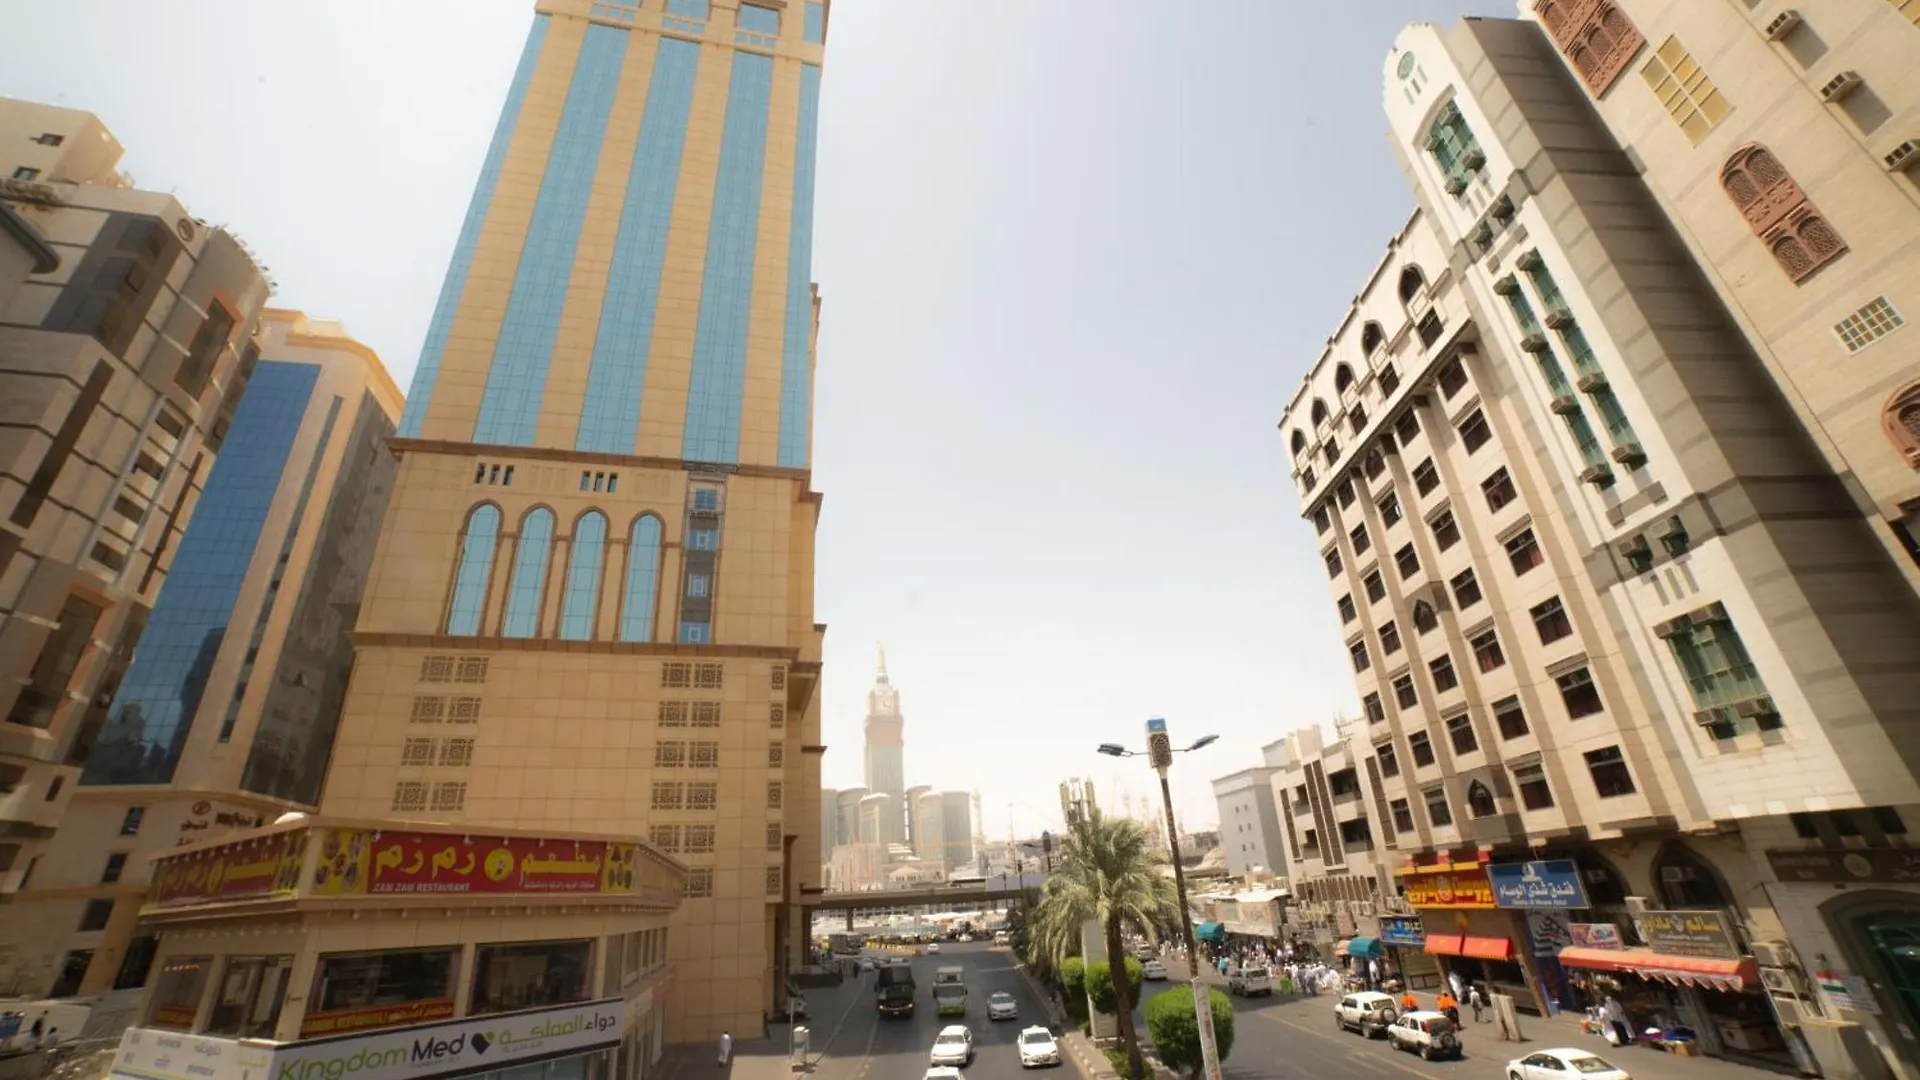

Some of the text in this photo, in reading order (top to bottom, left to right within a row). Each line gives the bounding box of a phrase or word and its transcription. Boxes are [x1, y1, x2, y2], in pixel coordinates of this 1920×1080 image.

[519, 848, 601, 887] مطعم
[371, 882, 471, 893] ZAM ZAM RESTAURANT
[499, 1013, 616, 1045] دواء المملكة
[278, 1047, 407, 1080] Kingdom
[411, 1032, 466, 1062] Med
